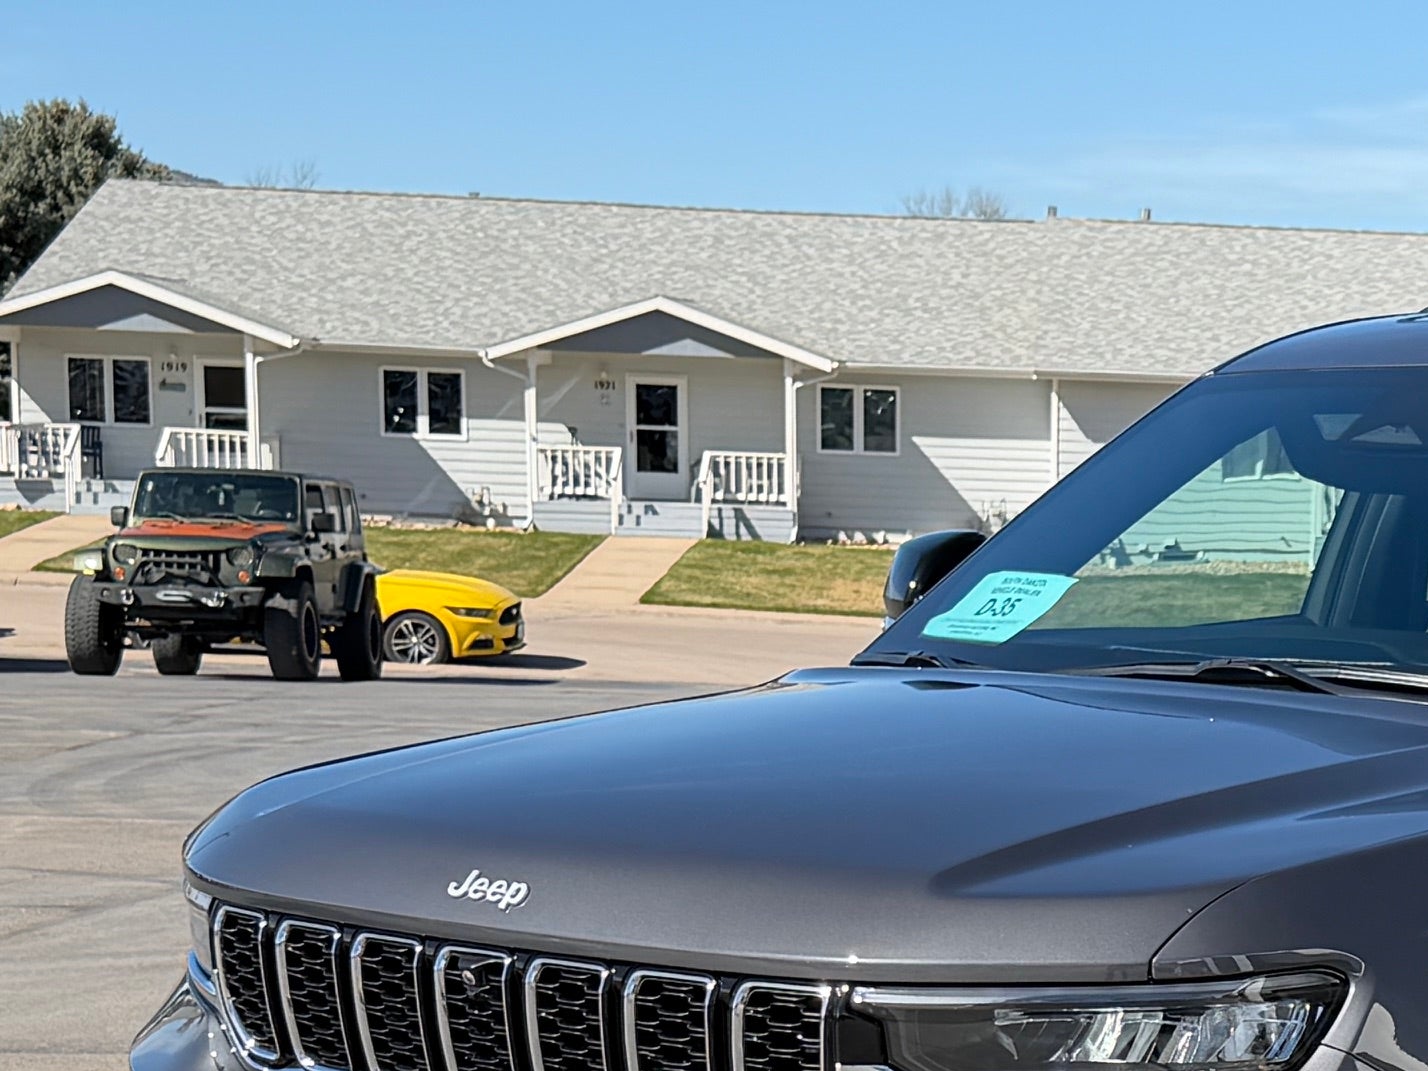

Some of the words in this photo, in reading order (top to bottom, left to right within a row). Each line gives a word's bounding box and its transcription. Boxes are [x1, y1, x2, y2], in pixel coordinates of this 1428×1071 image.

[161, 361, 188, 373] 1919
[974, 597, 1022, 617] D-35
[447, 869, 530, 911] Jeep
